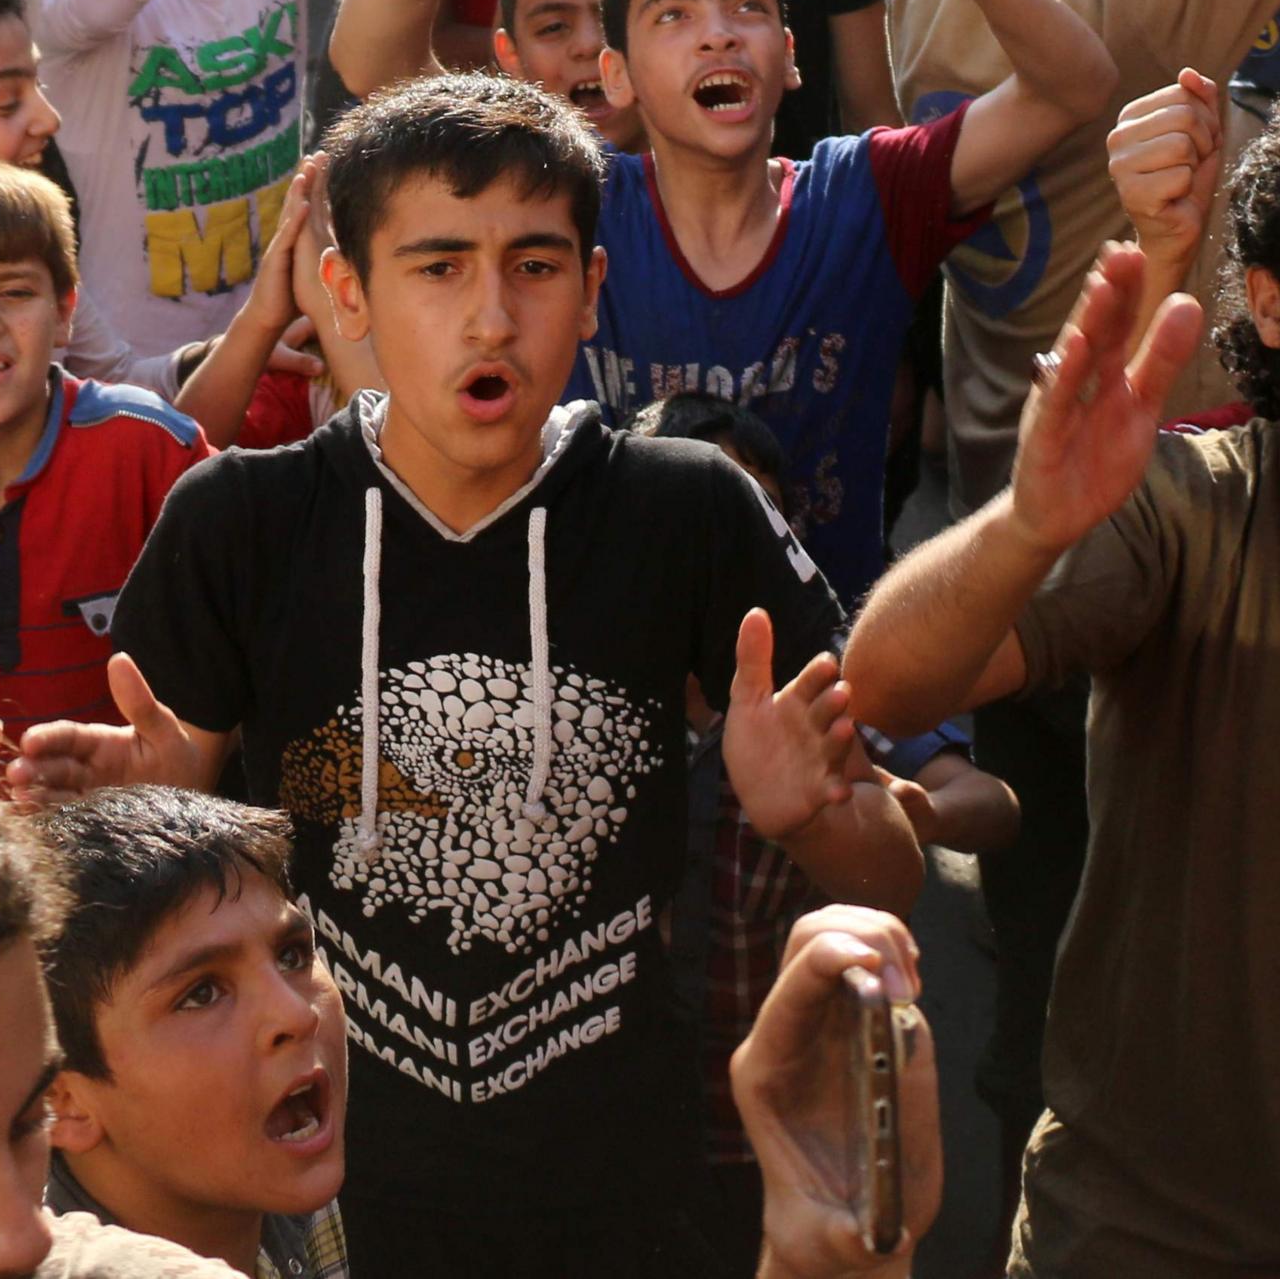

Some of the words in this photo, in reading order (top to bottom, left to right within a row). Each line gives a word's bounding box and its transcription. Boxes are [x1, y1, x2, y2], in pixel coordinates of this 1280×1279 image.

[141, 61, 296, 158] TOP
[468, 894, 653, 1026] EXCHANGE
[468, 951, 638, 1068] EXCHANGE
[470, 1005, 622, 1104] EXCHANGE
